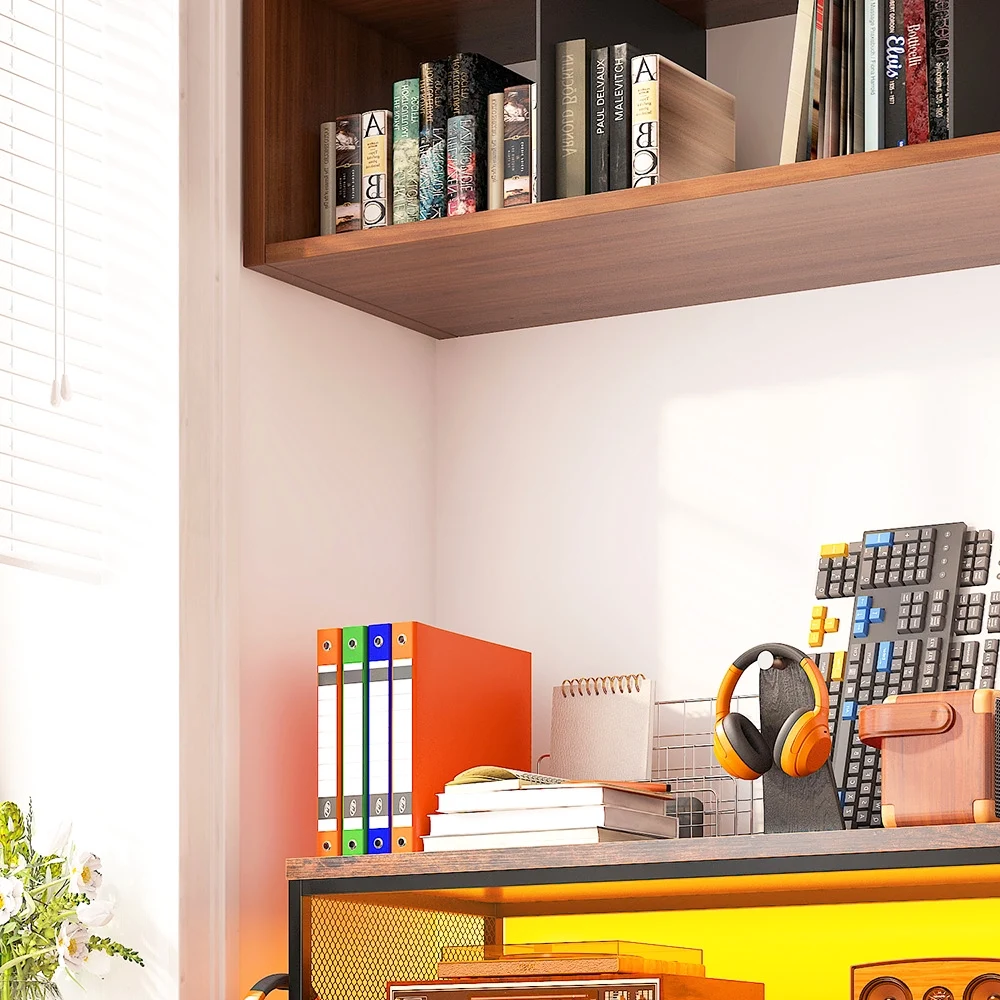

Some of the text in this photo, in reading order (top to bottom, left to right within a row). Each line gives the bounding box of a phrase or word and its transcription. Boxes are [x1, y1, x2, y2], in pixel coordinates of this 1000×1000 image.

[886, 35, 906, 78] Elvis
[908, 24, 922, 67] Botticelli
[596, 59, 605, 134] PAUL DELVAUX
[614, 58, 624, 122] MALEVITCH
